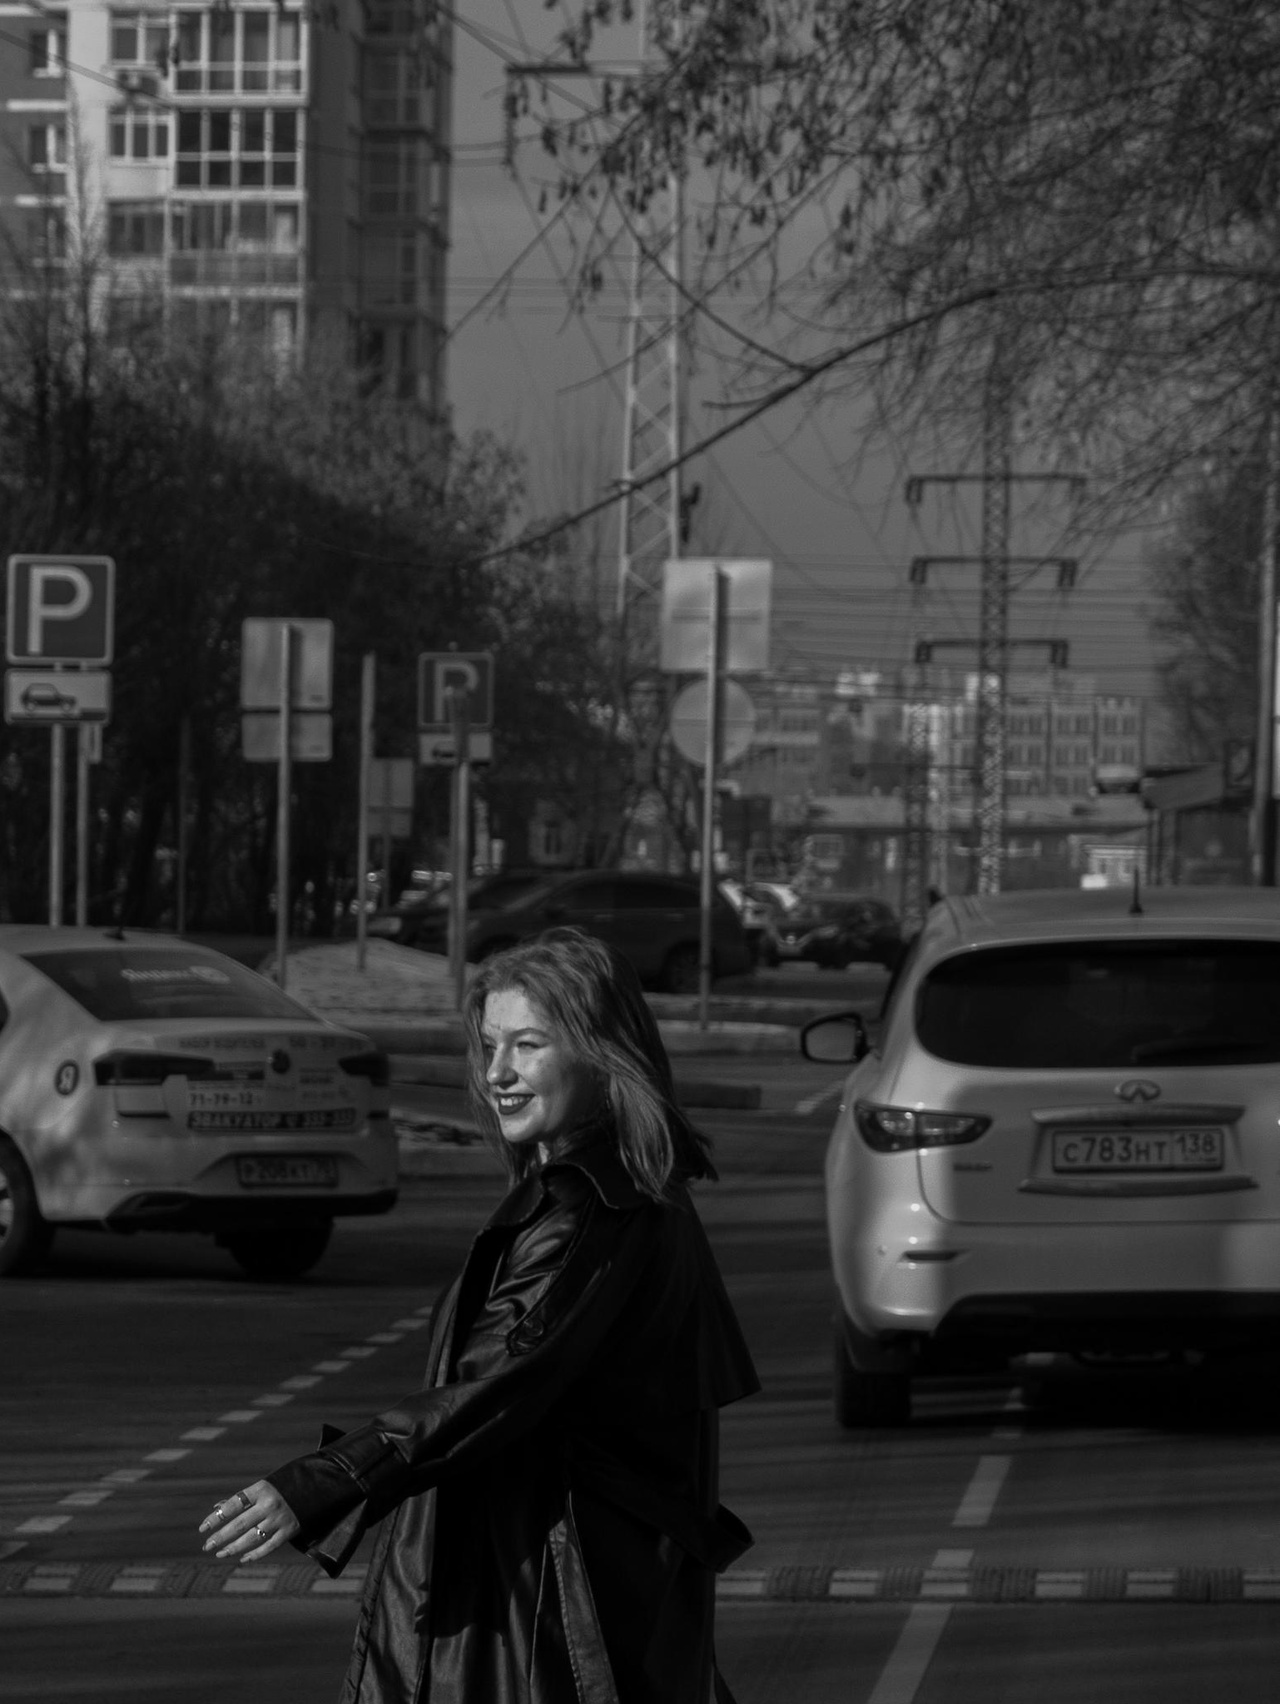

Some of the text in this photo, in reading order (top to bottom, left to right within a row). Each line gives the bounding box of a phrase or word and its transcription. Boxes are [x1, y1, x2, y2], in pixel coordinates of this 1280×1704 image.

[27, 564, 94, 656] P
[433, 660, 480, 722] P
[1175, 1132, 1216, 1155] 138
